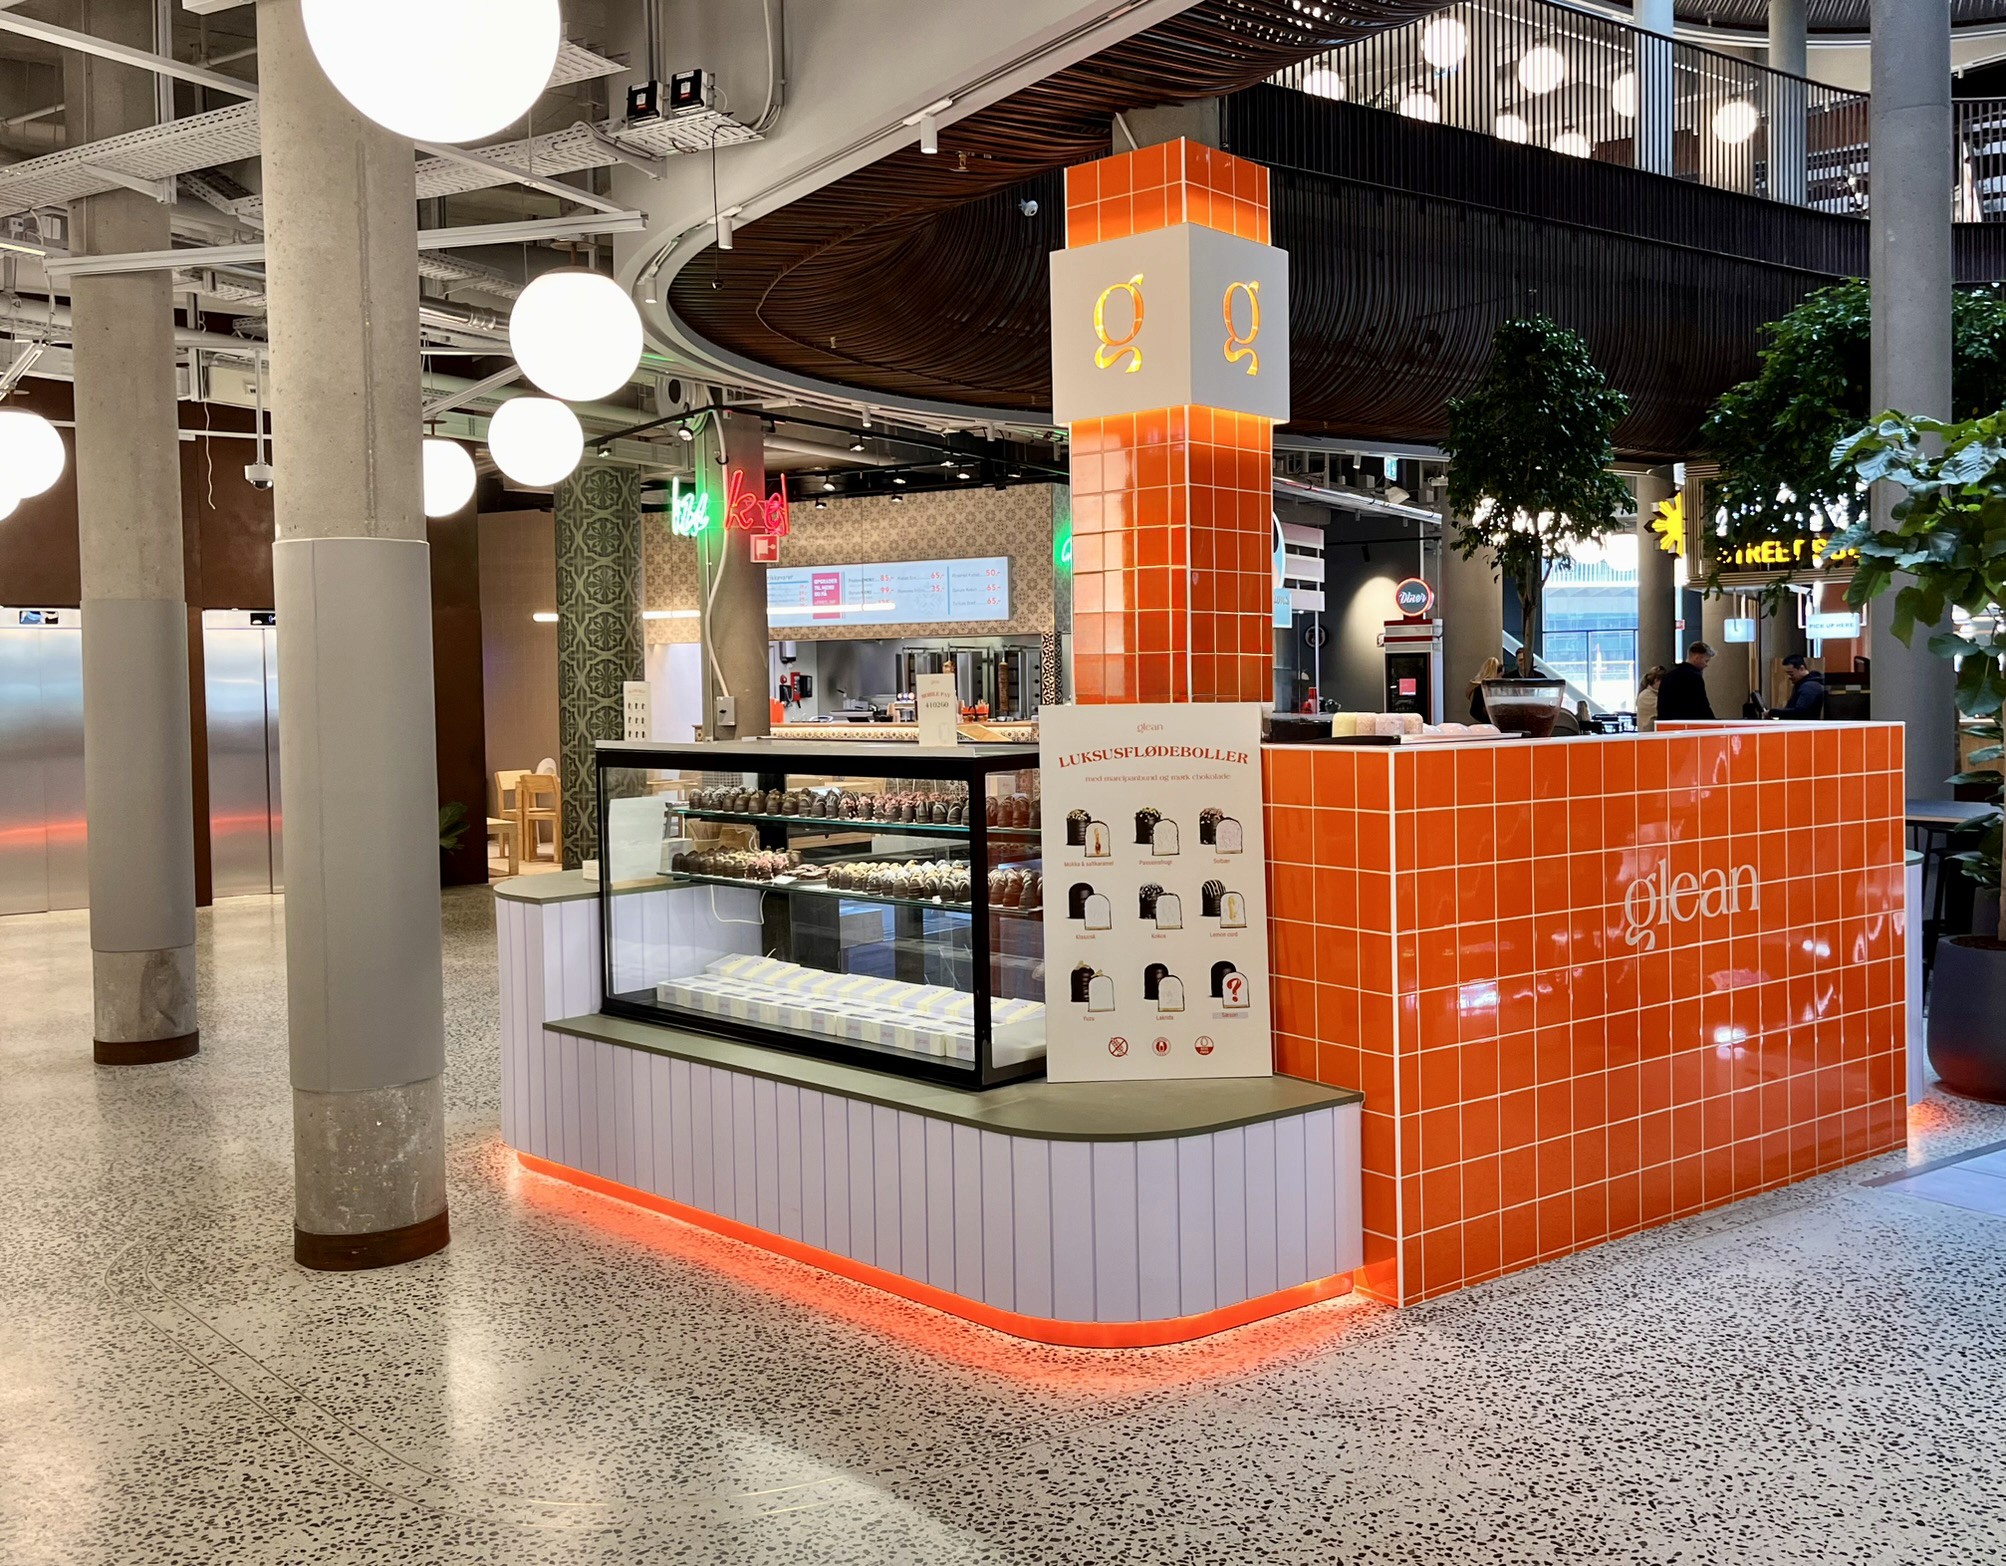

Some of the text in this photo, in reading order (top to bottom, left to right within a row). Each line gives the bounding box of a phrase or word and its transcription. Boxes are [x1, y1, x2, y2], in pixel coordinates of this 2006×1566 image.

[1093, 273, 1144, 374] g
[1222, 280, 1260, 376] g
[1058, 744, 1249, 769] LUKSUSFLØDEBOLLER
[1136, 722, 1164, 734] glean
[1104, 774, 1158, 783] marcipanbund
[1159, 775, 1169, 783] og
[1192, 773, 1231, 781] chokolade
[1624, 857, 1760, 951] glean
